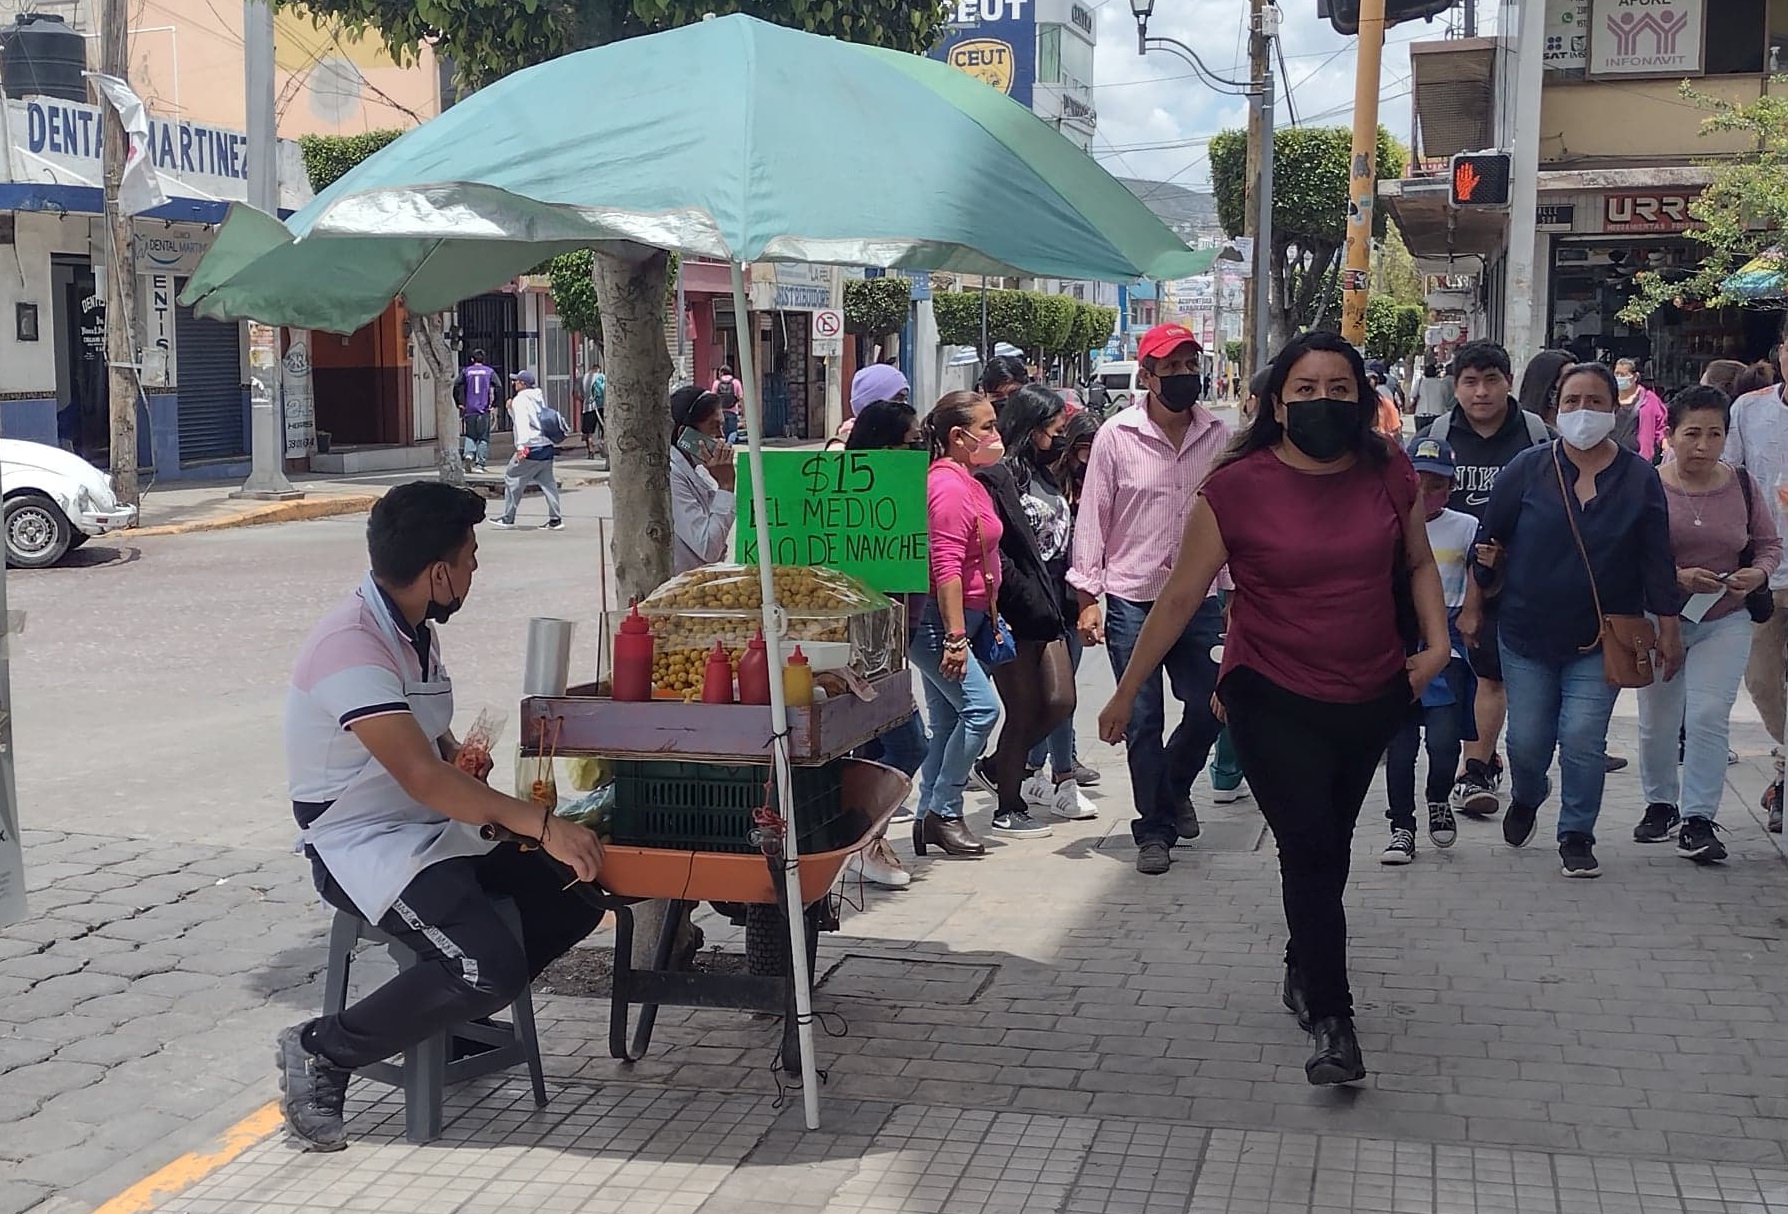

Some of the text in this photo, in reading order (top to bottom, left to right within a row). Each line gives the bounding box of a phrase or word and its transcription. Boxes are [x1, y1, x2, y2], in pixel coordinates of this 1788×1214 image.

[955, 49, 1006, 67] CEUT
[1605, 55, 1687, 67] INFONAVIT
[149, 239, 178, 252] DENTAL
[802, 453, 875, 496] $15
[1452, 466, 1505, 491] NIK
[803, 496, 897, 531] MEDIO
[807, 532, 839, 566] DE
[845, 532, 929, 562] NANCHE
